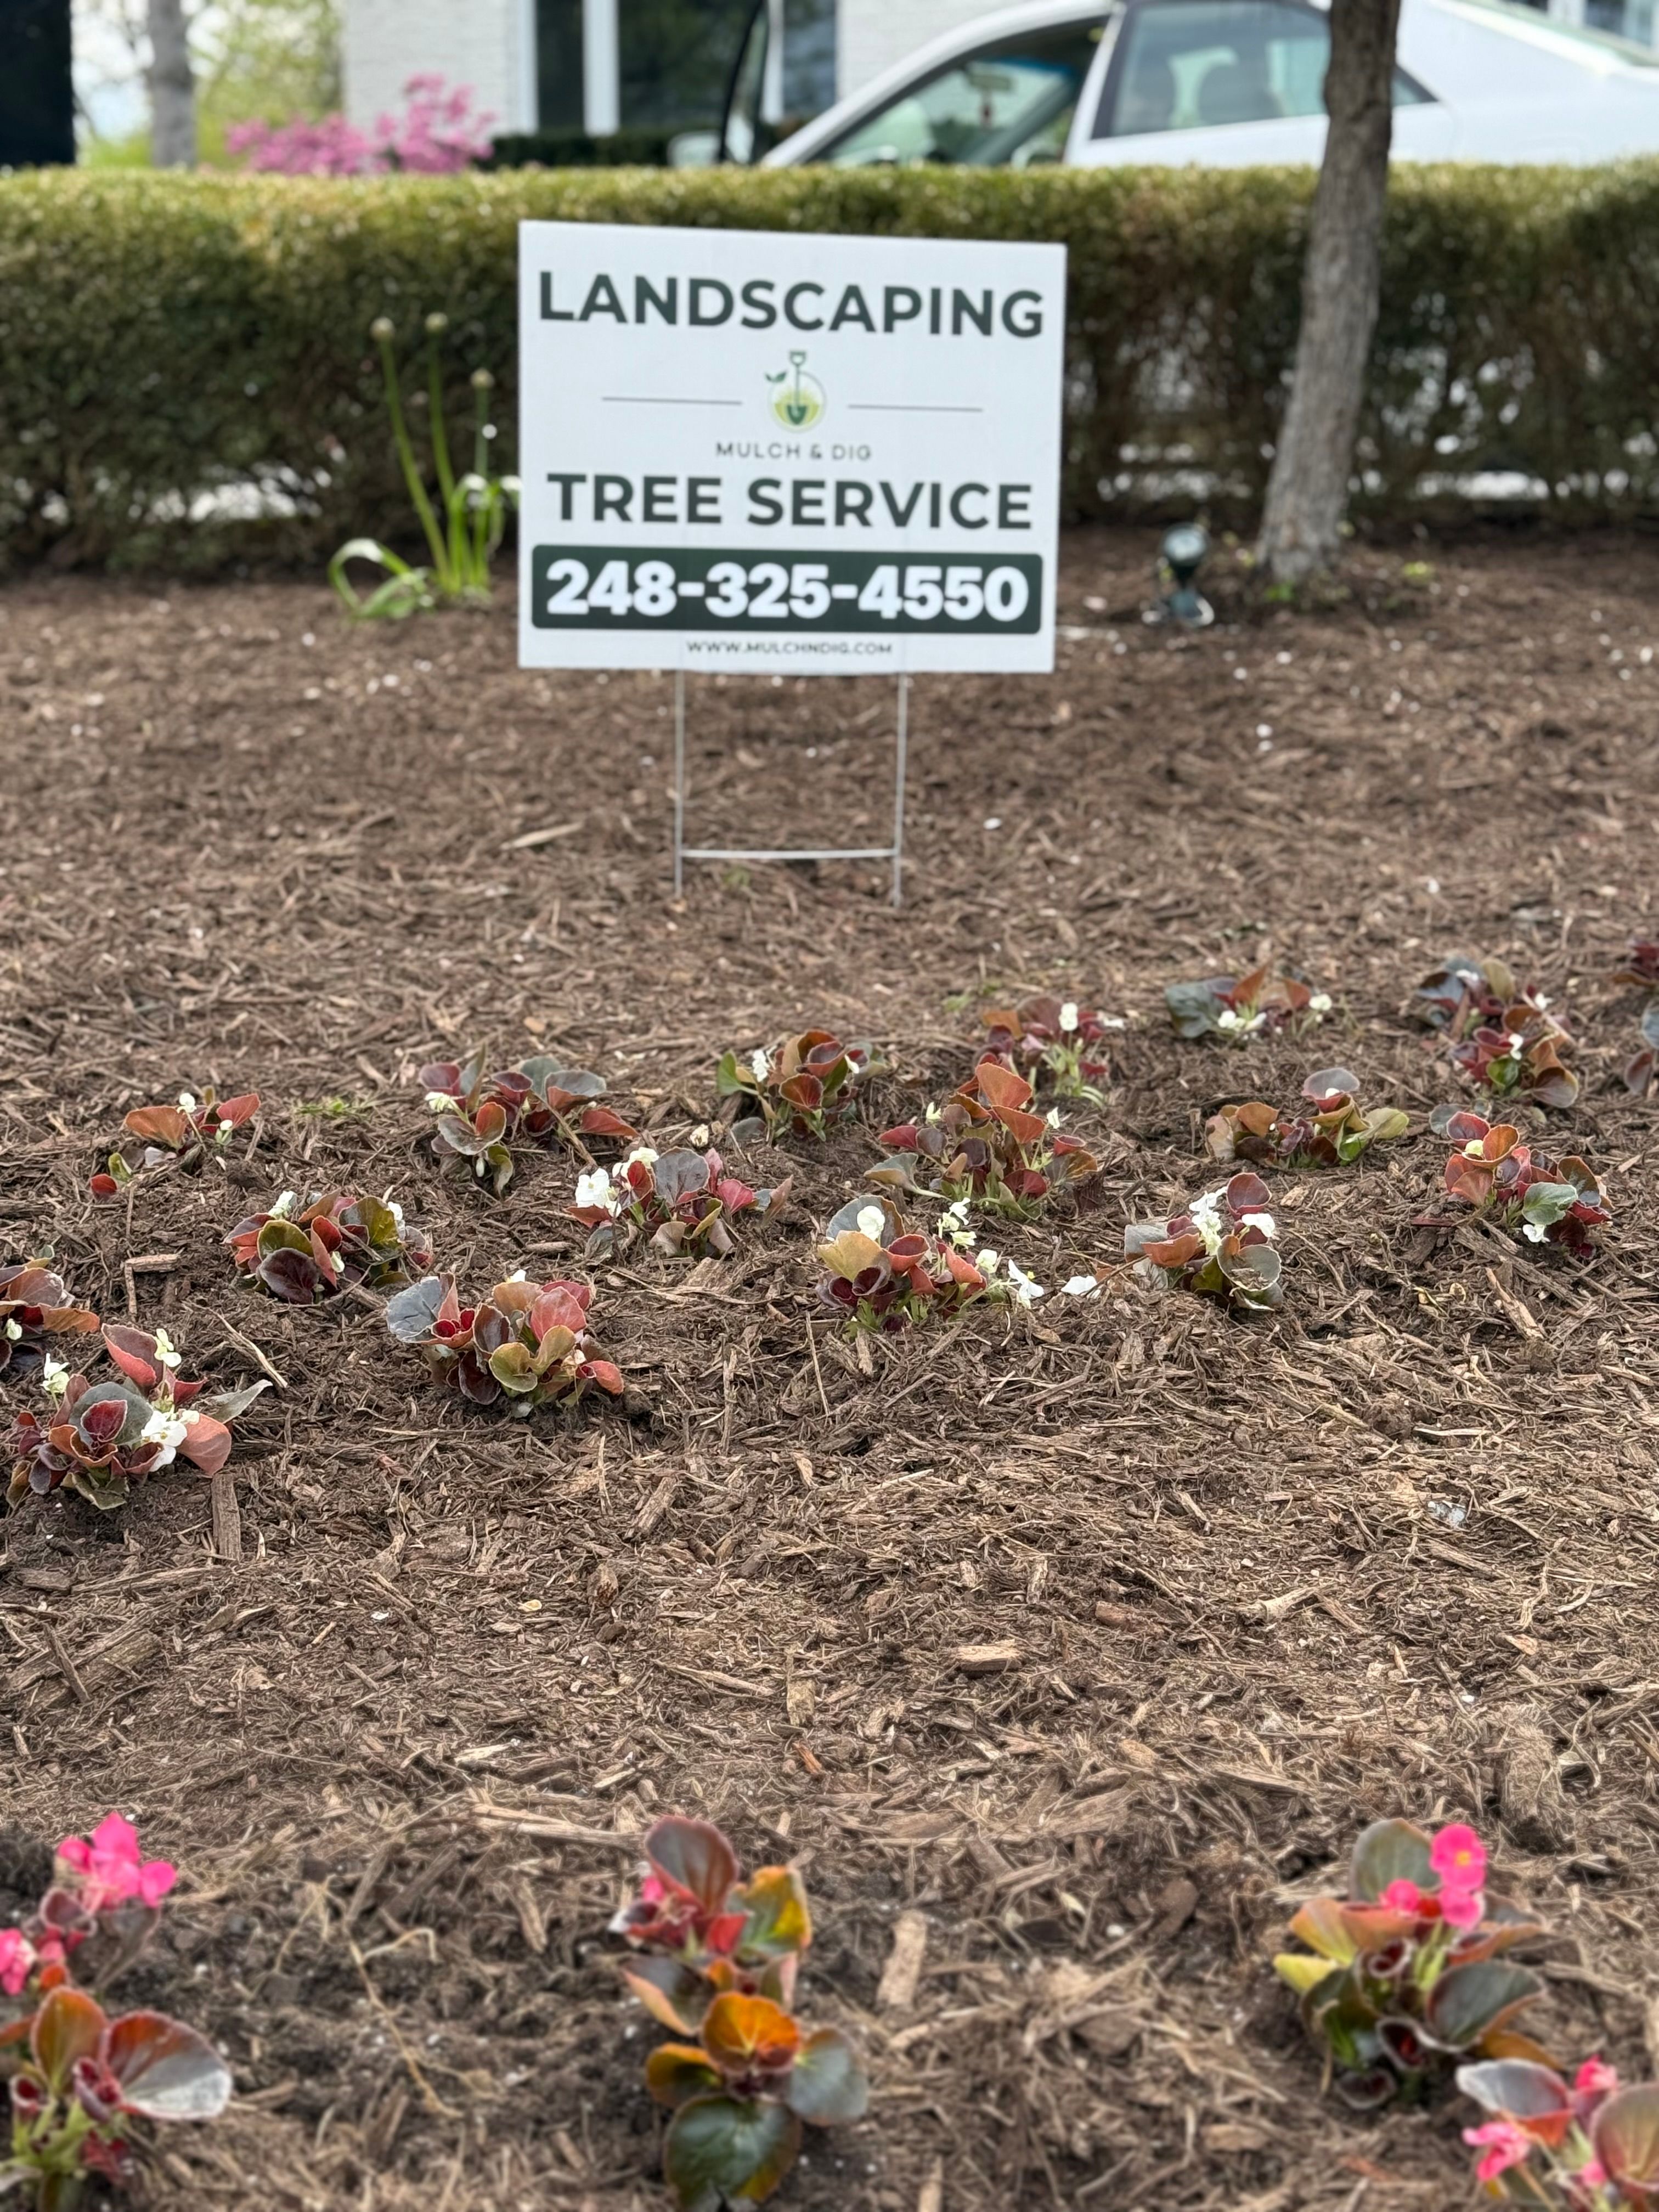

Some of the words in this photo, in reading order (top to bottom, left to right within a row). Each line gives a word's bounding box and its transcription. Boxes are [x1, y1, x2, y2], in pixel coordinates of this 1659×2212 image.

[539, 270, 1043, 340] LANDSCAPING
[716, 442, 799, 459] MULCH
[809, 444, 822, 460] &
[832, 444, 872, 461] DIG
[546, 472, 723, 525] TREE
[746, 476, 1032, 531] SERVICE
[546, 558, 1030, 622] 248-325-4550
[686, 640, 893, 655] WWW.MULCHNDIG.COM
